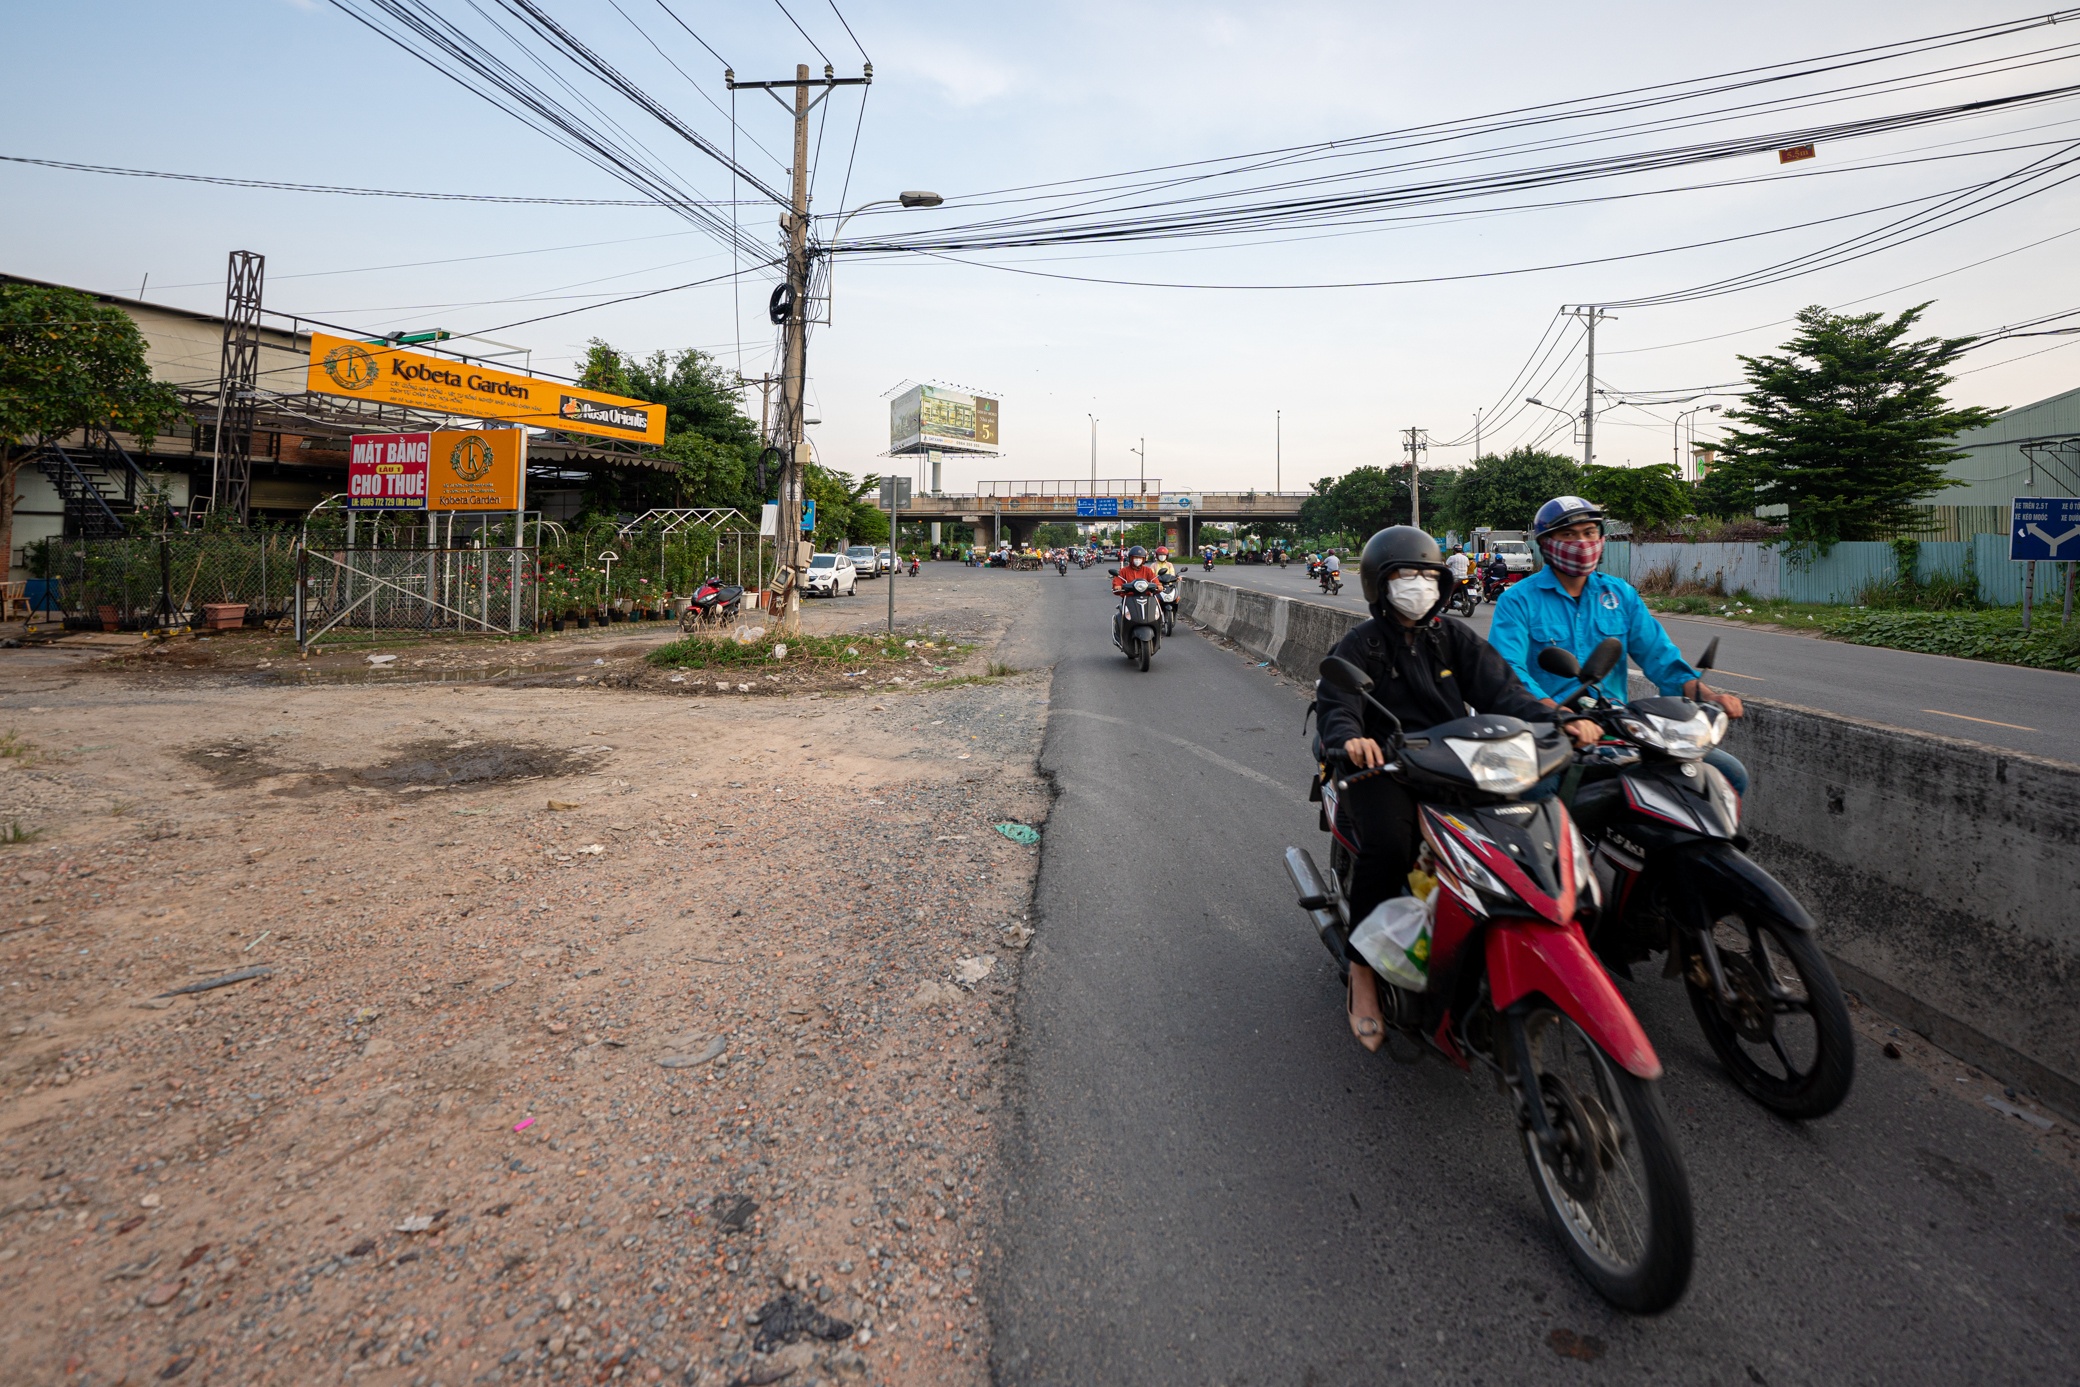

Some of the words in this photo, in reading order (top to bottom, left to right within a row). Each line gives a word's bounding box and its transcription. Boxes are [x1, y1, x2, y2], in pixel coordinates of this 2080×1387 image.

[1787, 149, 1809, 159] 5.5m
[392, 358, 461, 387] Kobeta
[467, 374, 529, 400] Garden
[583, 403, 609, 423] Rosa
[609, 409, 647, 428] Orientis
[982, 424, 989, 440] 5
[352, 440, 384, 467] MẶT
[386, 436, 427, 463] BẰNG
[351, 474, 382, 496] CHO
[386, 470, 425, 495] THUÊ
[375, 497, 384, 506] 772
[385, 497, 395, 506] 729
[439, 495, 468, 506] Kobeta
[470, 495, 501, 505] Garden
[2015, 502, 2022, 510] XE
[2022, 501, 2035, 510] TRÊN
[2061, 502, 2068, 510] XE
[2069, 501, 2074, 510] Ô
[2022, 512, 2033, 520] KÉO
[2033, 512, 2048, 521] MOÓC
[2061, 514, 2068, 522] XE
